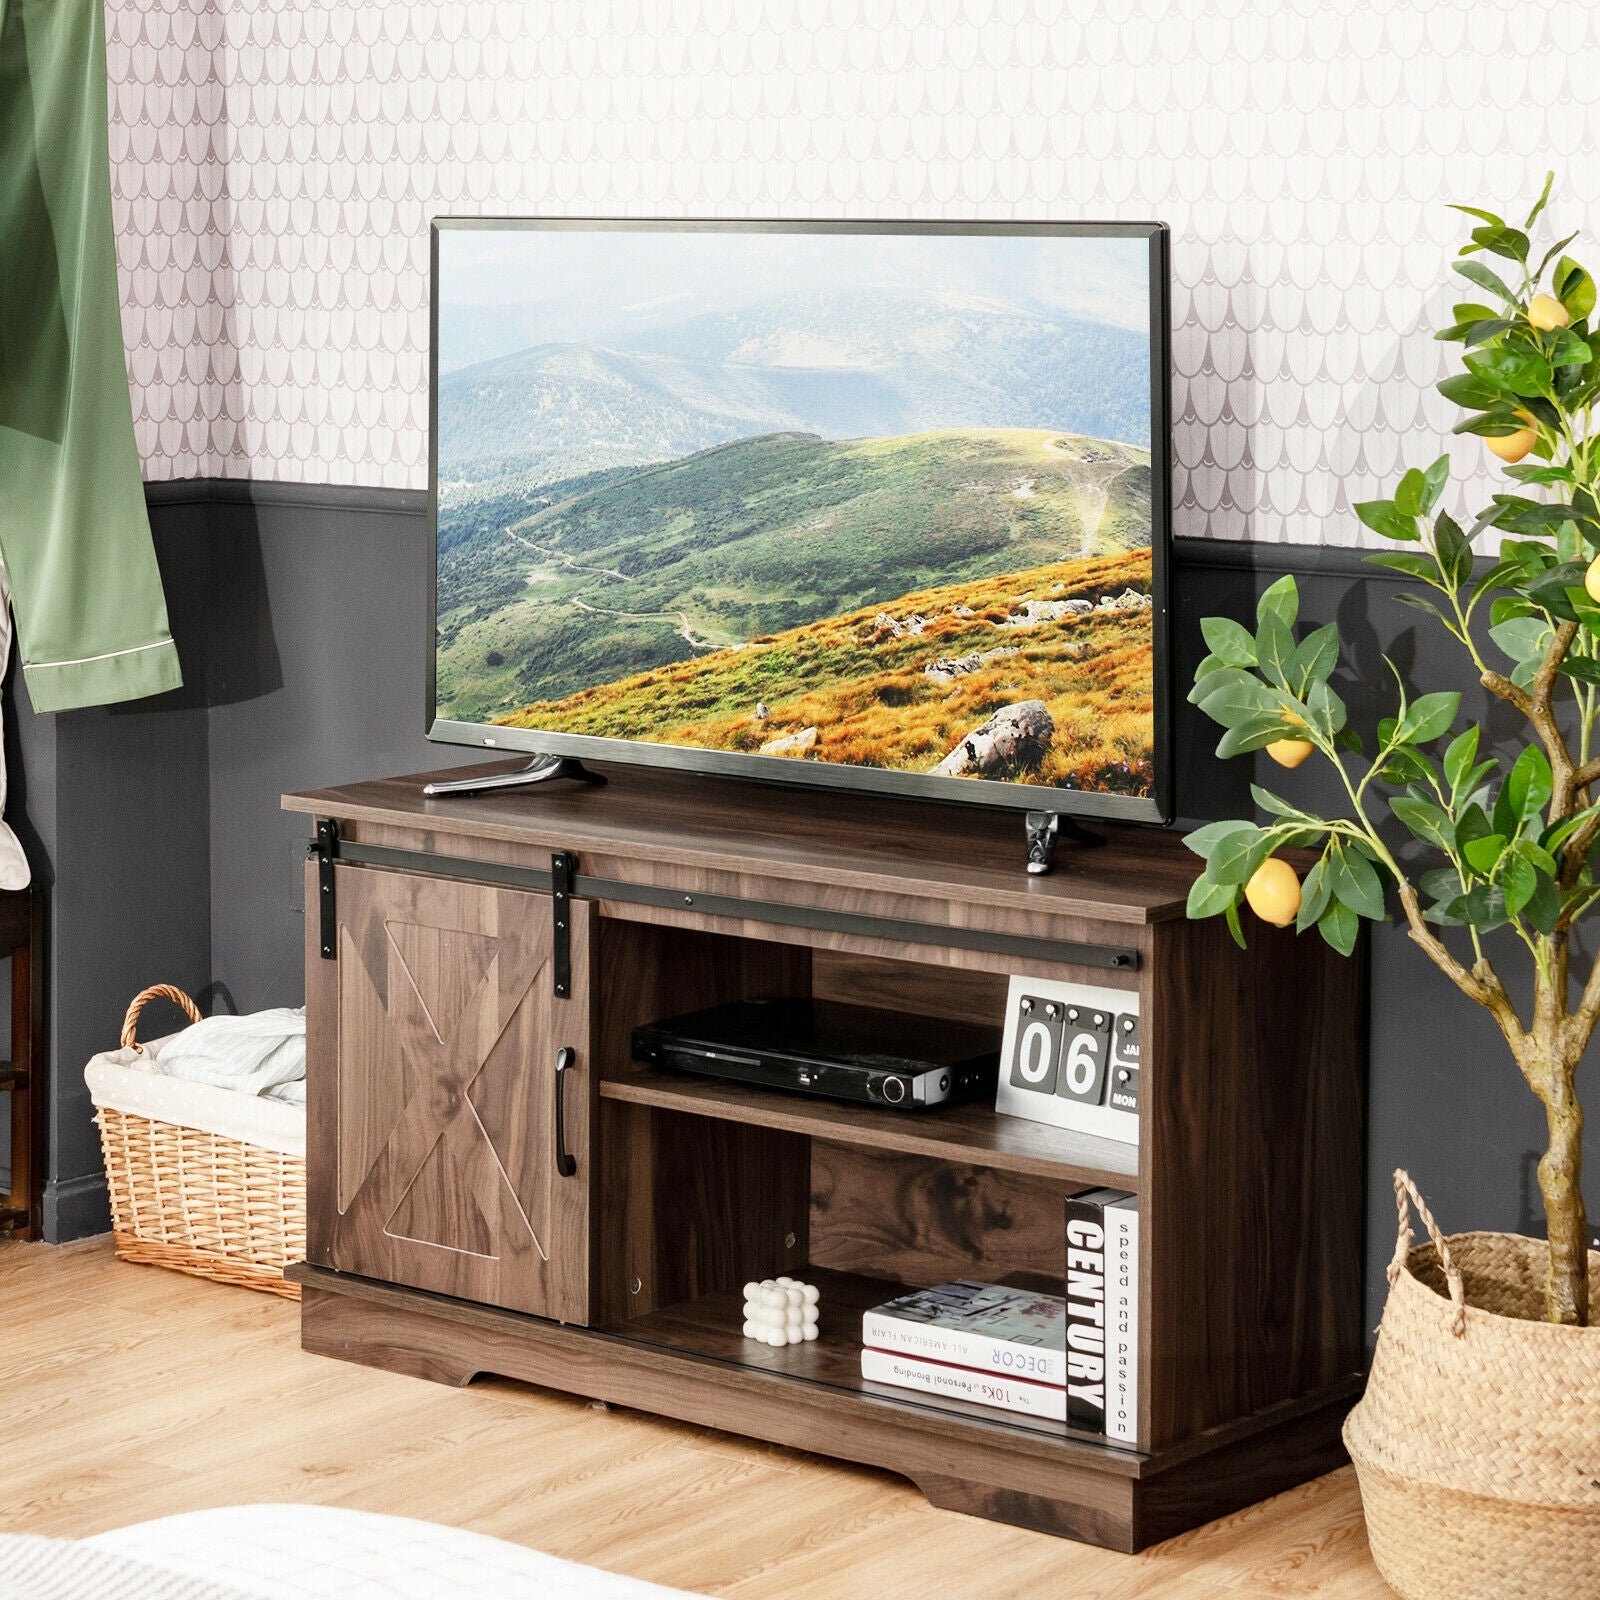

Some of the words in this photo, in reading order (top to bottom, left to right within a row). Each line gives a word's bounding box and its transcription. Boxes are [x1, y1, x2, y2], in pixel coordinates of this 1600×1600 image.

[1112, 1093, 1137, 1108] MON
[1119, 1224, 1129, 1287] speed
[1066, 1219, 1105, 1410] CENTURY
[1119, 1297, 1129, 1334] and
[871, 1327, 898, 1341] FLAIR
[992, 1349, 1047, 1374] DECOR
[893, 1365, 931, 1383] Branding
[934, 1376, 972, 1392] Personal
[982, 1385, 1010, 1403] 10Ks
[1117, 1343, 1129, 1433] passion
